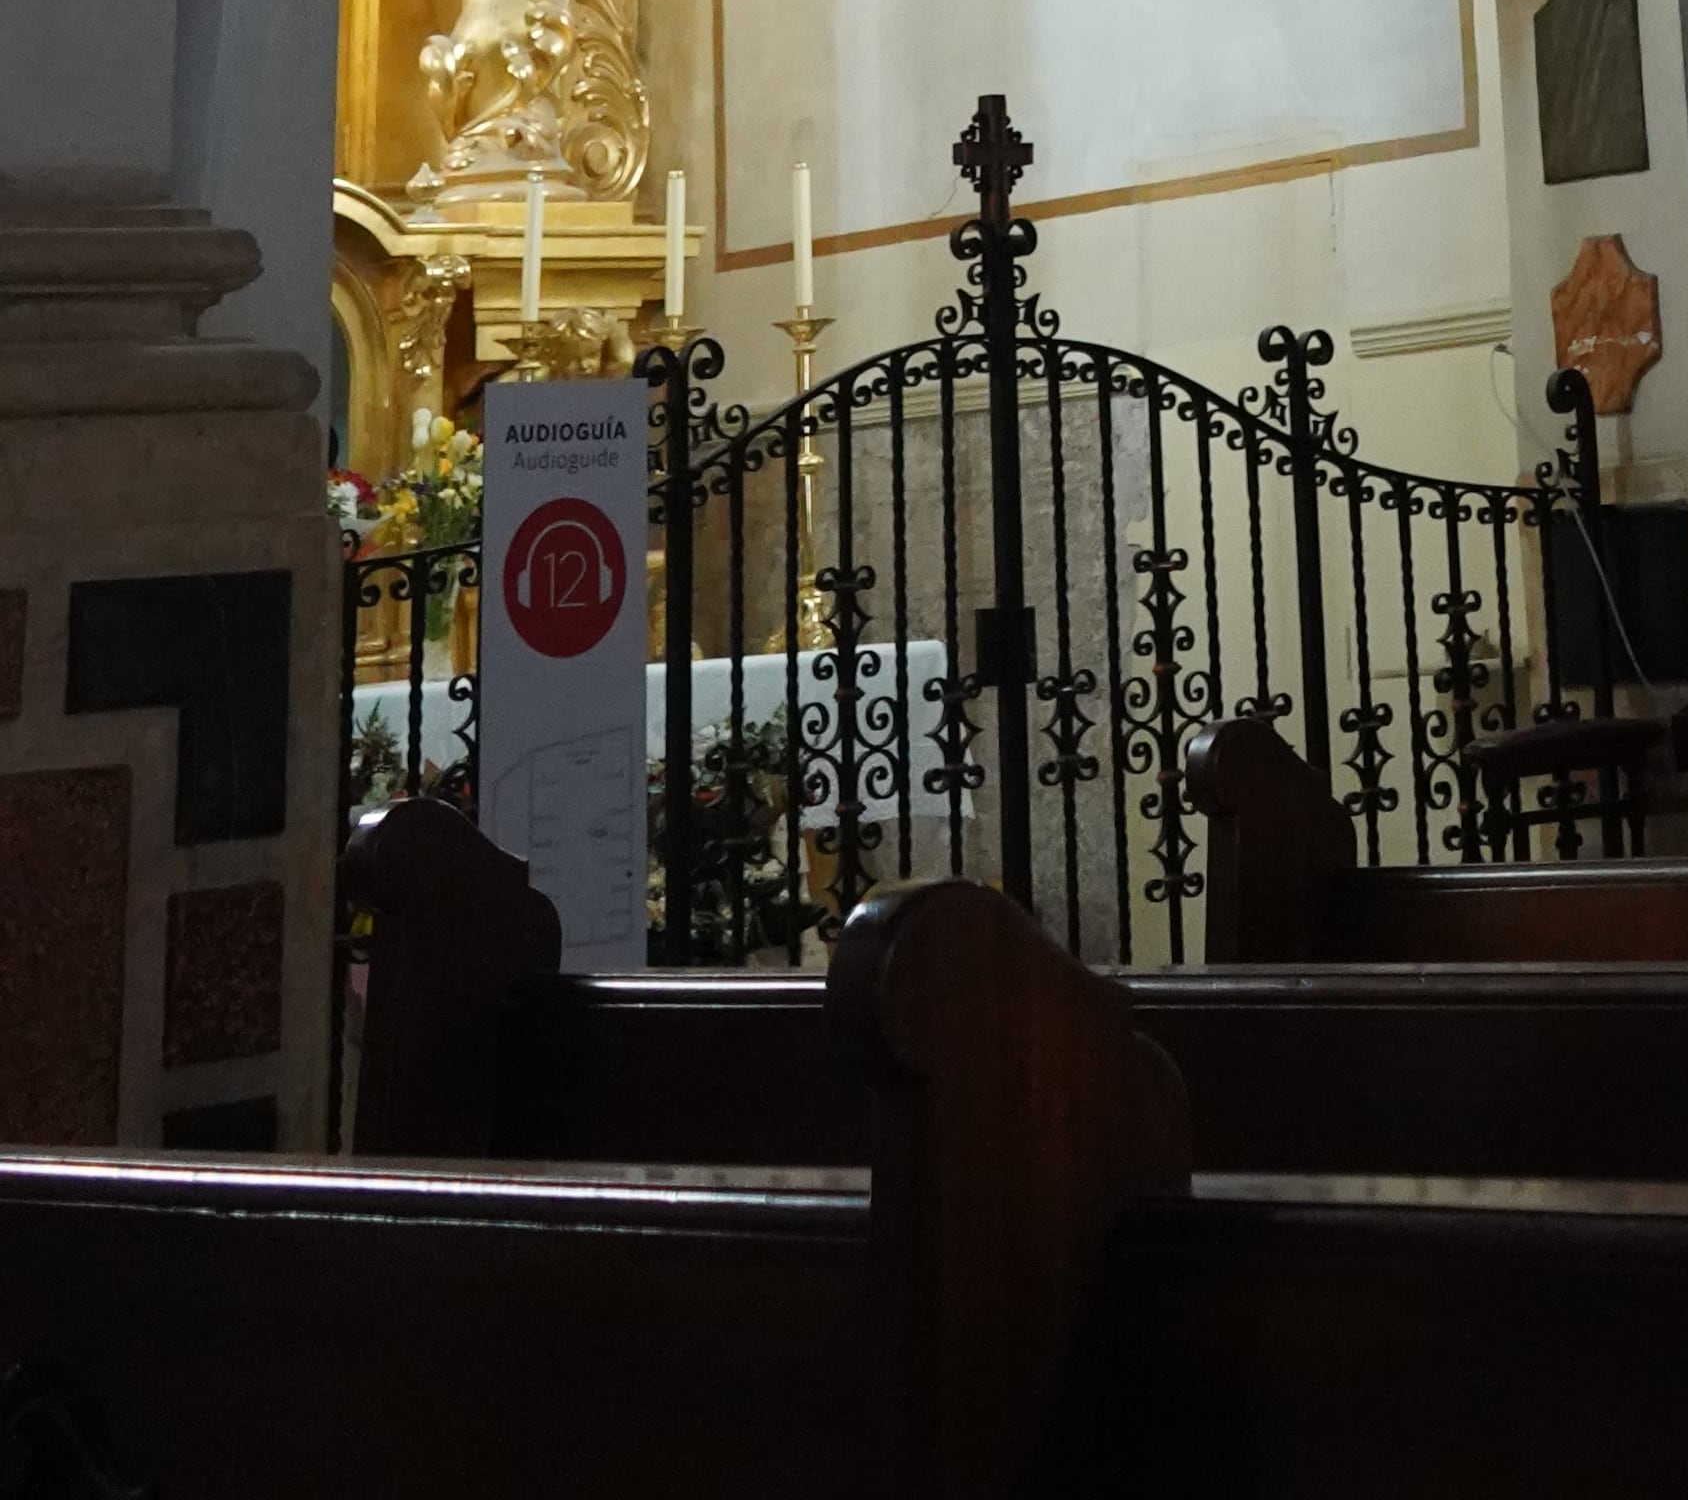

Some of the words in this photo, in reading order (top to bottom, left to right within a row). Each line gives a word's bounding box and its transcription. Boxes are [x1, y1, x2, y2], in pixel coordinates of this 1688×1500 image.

[505, 415, 627, 444] AUDIOGUÍA
[513, 448, 620, 474] Audioguide
[543, 550, 588, 609] 12
